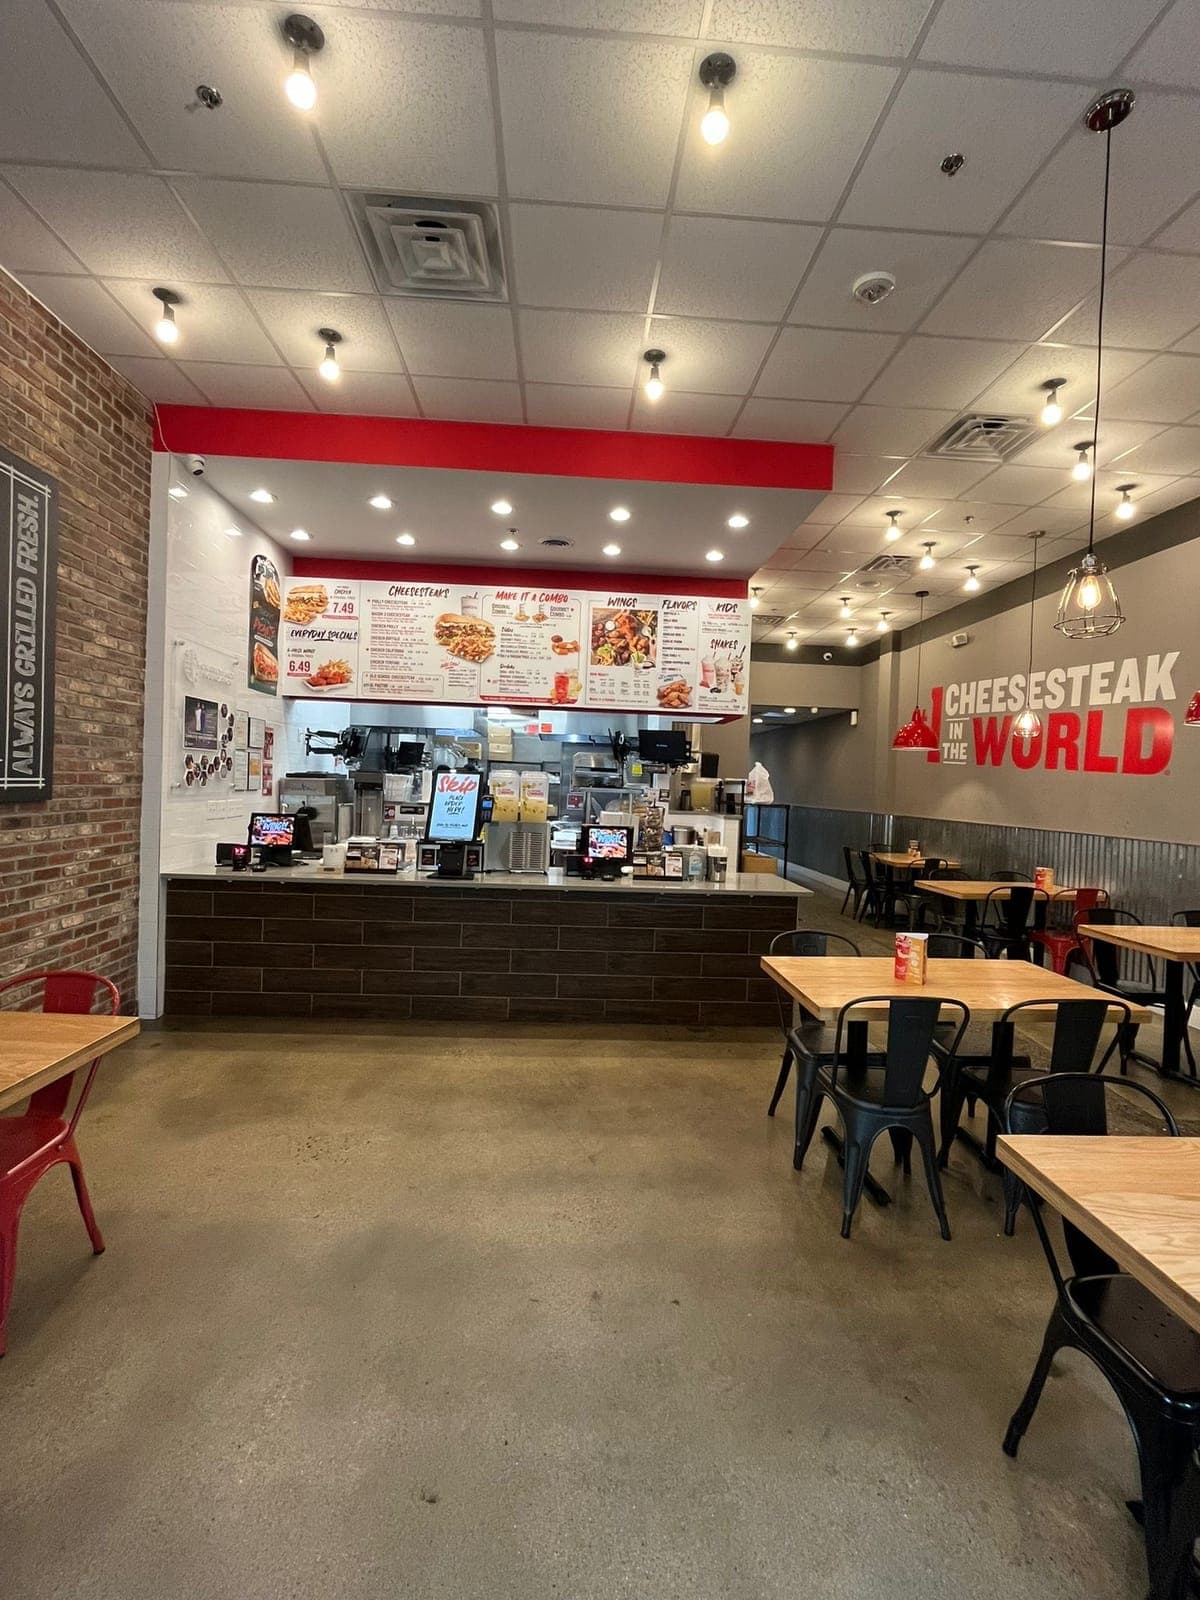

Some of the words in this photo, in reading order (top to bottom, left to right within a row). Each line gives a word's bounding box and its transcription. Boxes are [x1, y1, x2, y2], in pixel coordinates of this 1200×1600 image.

[16, 493, 39, 575] FRESH.
[388, 585, 450, 598] CHEESESTEAKS
[495, 591, 517, 601] MAKE
[520, 592, 531, 601] IT
[539, 592, 569, 603] COMBO
[333, 602, 354, 614] 7.49
[607, 596, 638, 608] WINGS
[662, 599, 698, 611] FLAVORS
[716, 602, 738, 613] KIDS
[14, 576, 38, 677] GRILLED
[710, 638, 738, 650] SHAKES
[289, 660, 311, 672] 6.49
[945, 651, 1181, 717] CHEESESTEAK
[12, 682, 35, 775] ALWAYS
[949, 722, 964, 740] IN
[973, 707, 1175, 776] WORLD
[943, 742, 968, 760] THE
[438, 774, 477, 794] Skip
